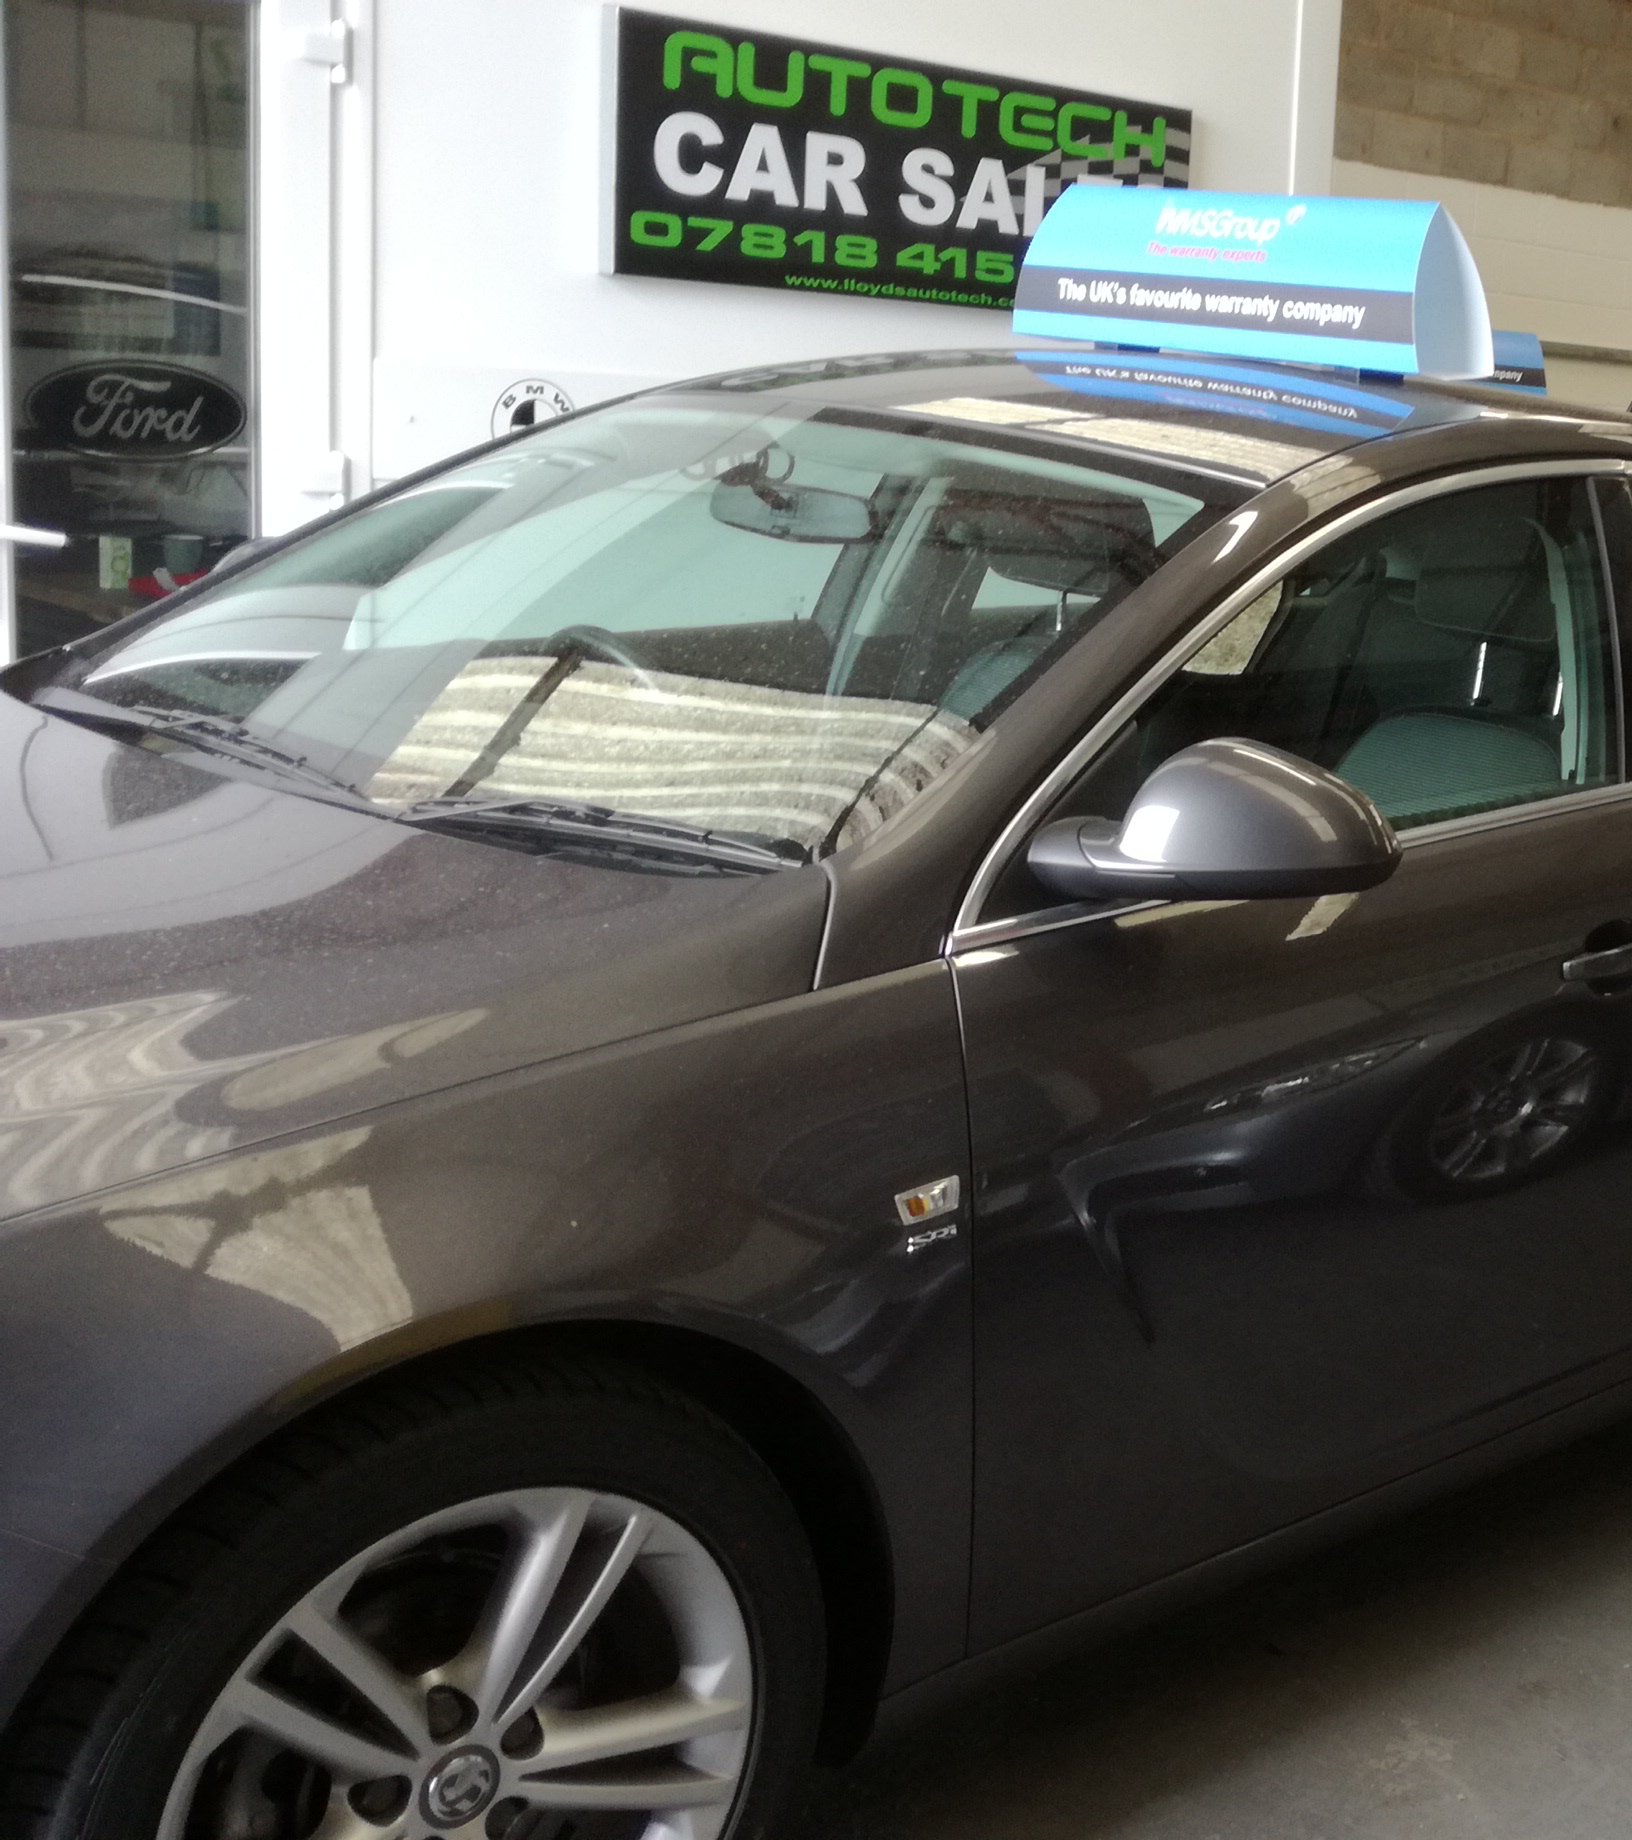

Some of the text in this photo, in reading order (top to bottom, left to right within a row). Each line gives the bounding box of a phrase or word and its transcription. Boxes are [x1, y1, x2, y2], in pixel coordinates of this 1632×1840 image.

[663, 31, 1167, 168] AUTOTECH
[653, 111, 869, 217] CAR
[629, 210, 1015, 284] 07818 415
[1147, 241, 1268, 263] The warranty experts
[1057, 278, 1366, 330] The UK's favourite warranty company
[72, 374, 204, 442] Ford
[501, 385, 569, 413] BMW
